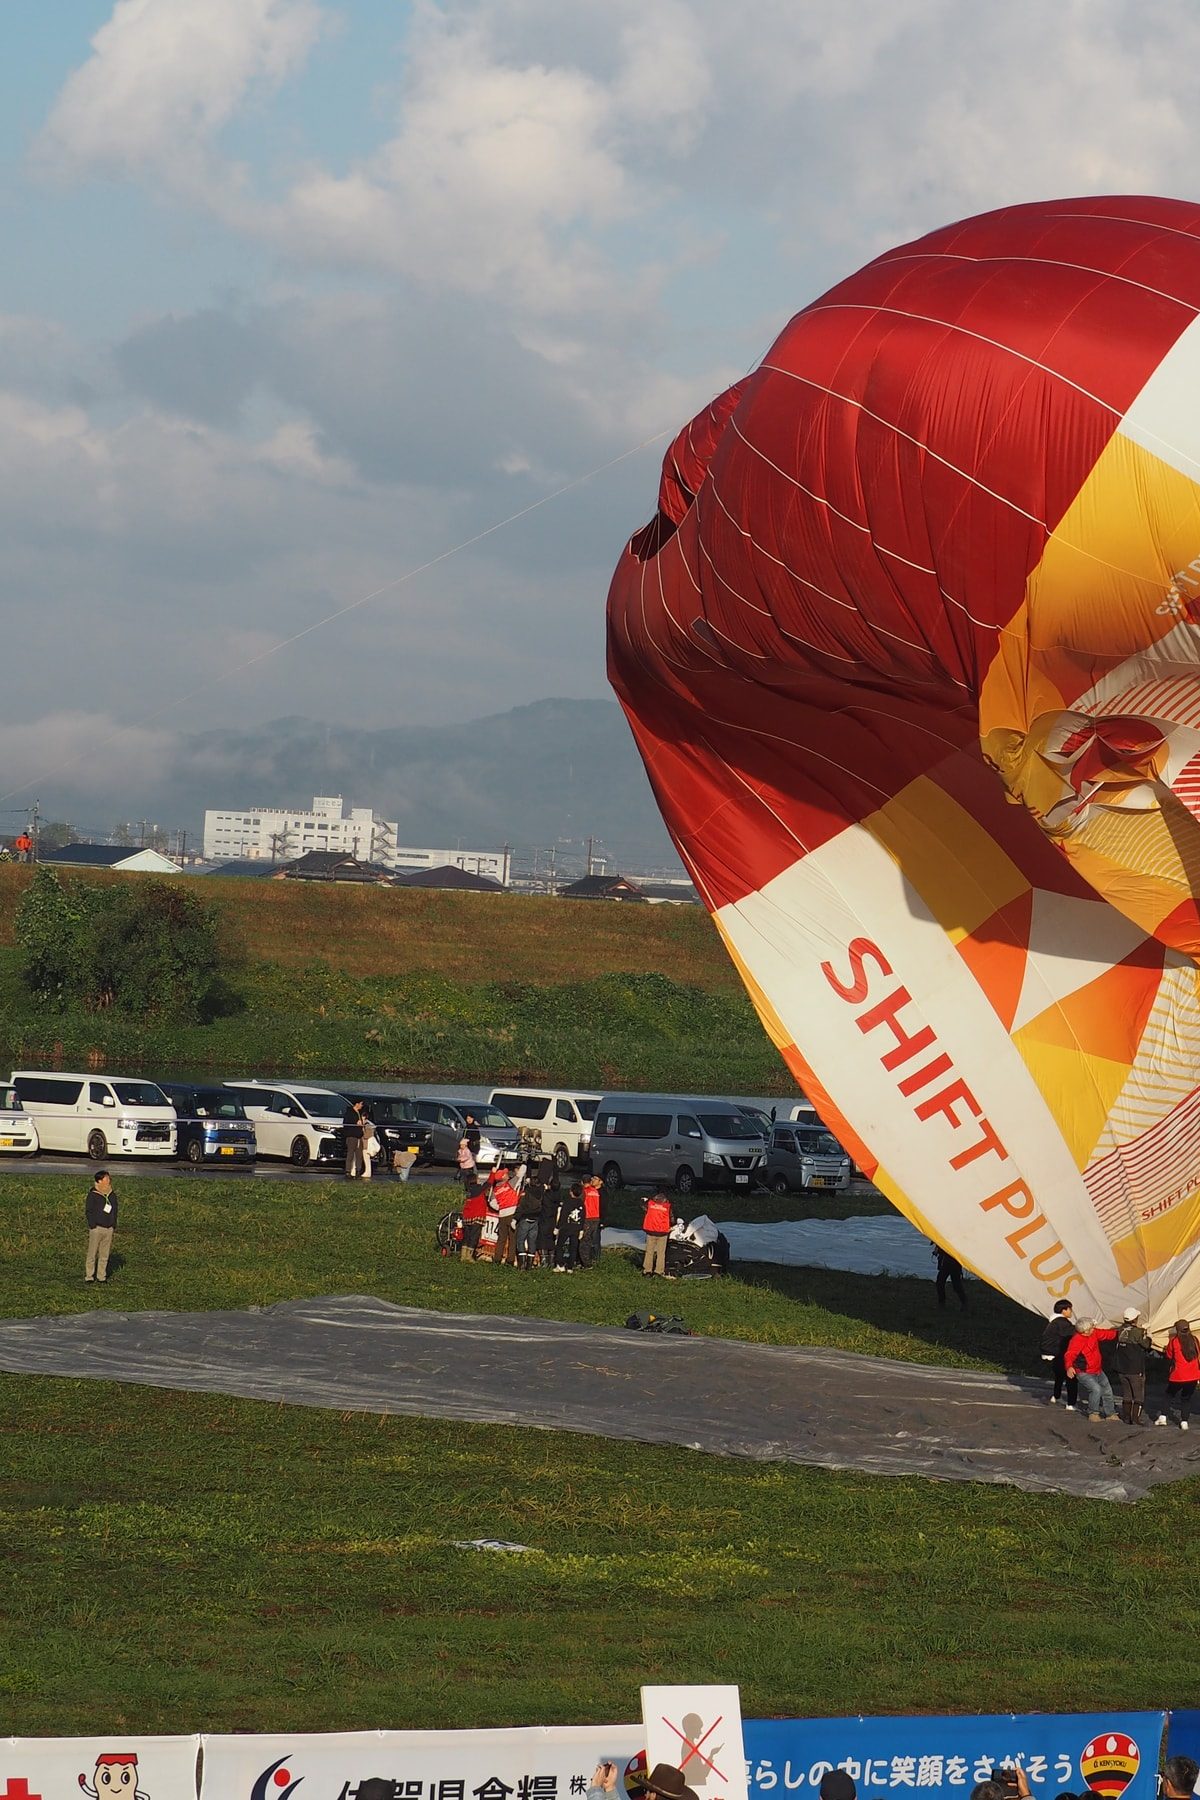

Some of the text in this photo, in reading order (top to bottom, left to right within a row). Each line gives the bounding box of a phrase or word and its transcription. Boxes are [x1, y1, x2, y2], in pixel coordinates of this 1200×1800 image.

[820, 937, 1086, 1298] SHIFT PLUS
[1141, 1189, 1184, 1221] SHIFT
